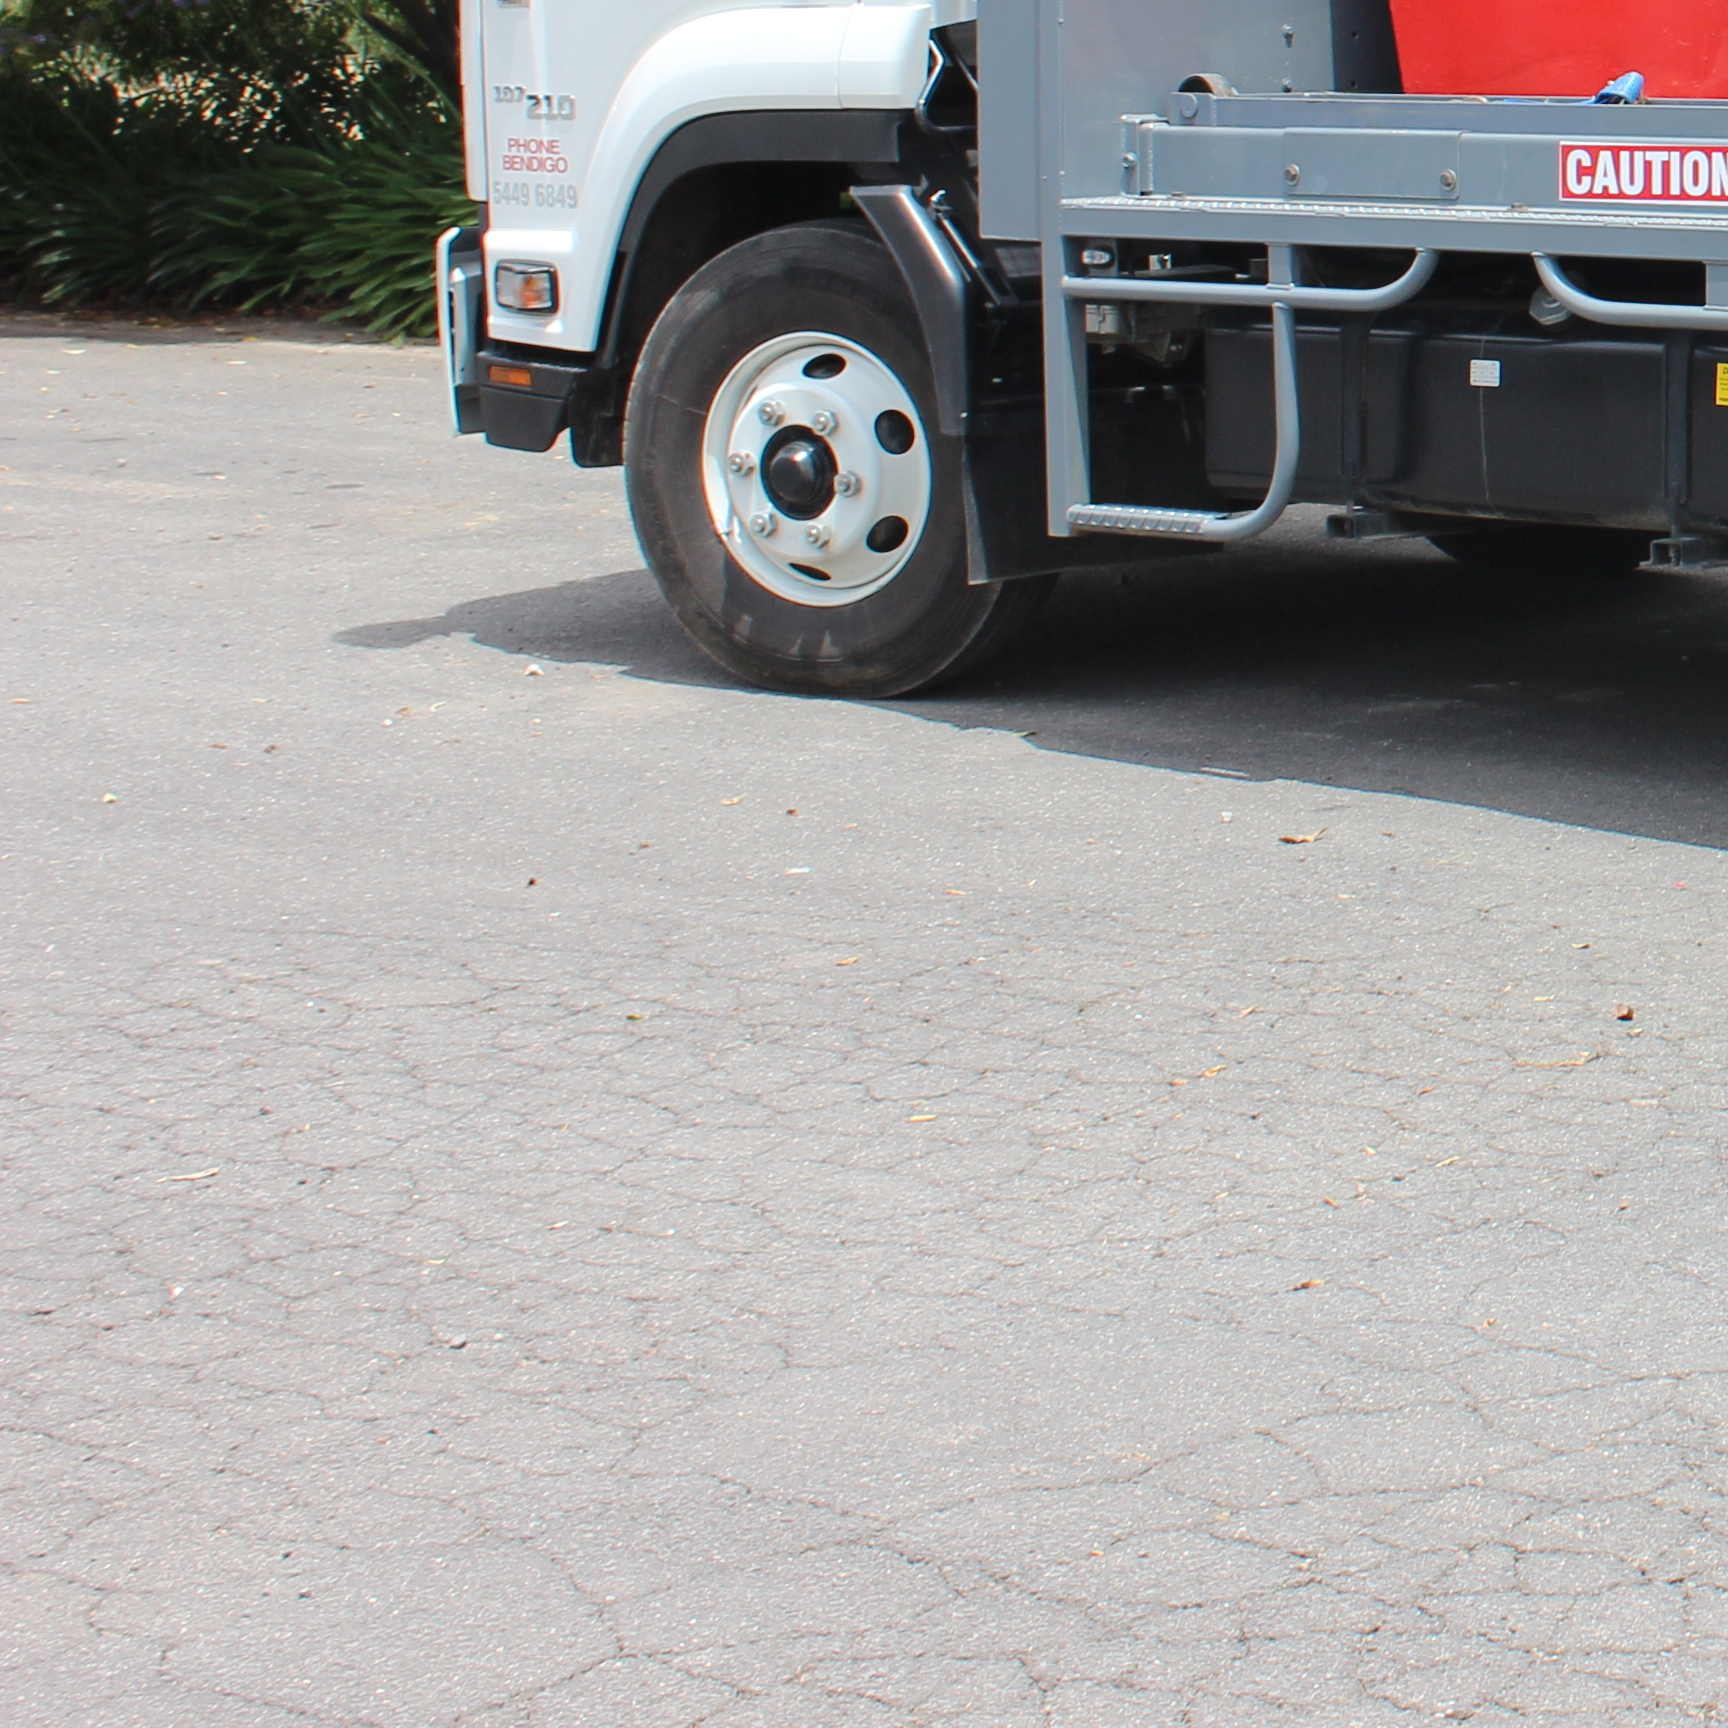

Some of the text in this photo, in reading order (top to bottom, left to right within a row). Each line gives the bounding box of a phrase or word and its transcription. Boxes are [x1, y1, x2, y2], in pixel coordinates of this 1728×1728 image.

[526, 94, 577, 120] 210
[507, 137, 562, 154] PHONE
[502, 154, 568, 174] BENDIGO
[493, 180, 578, 209] 5449 6849
